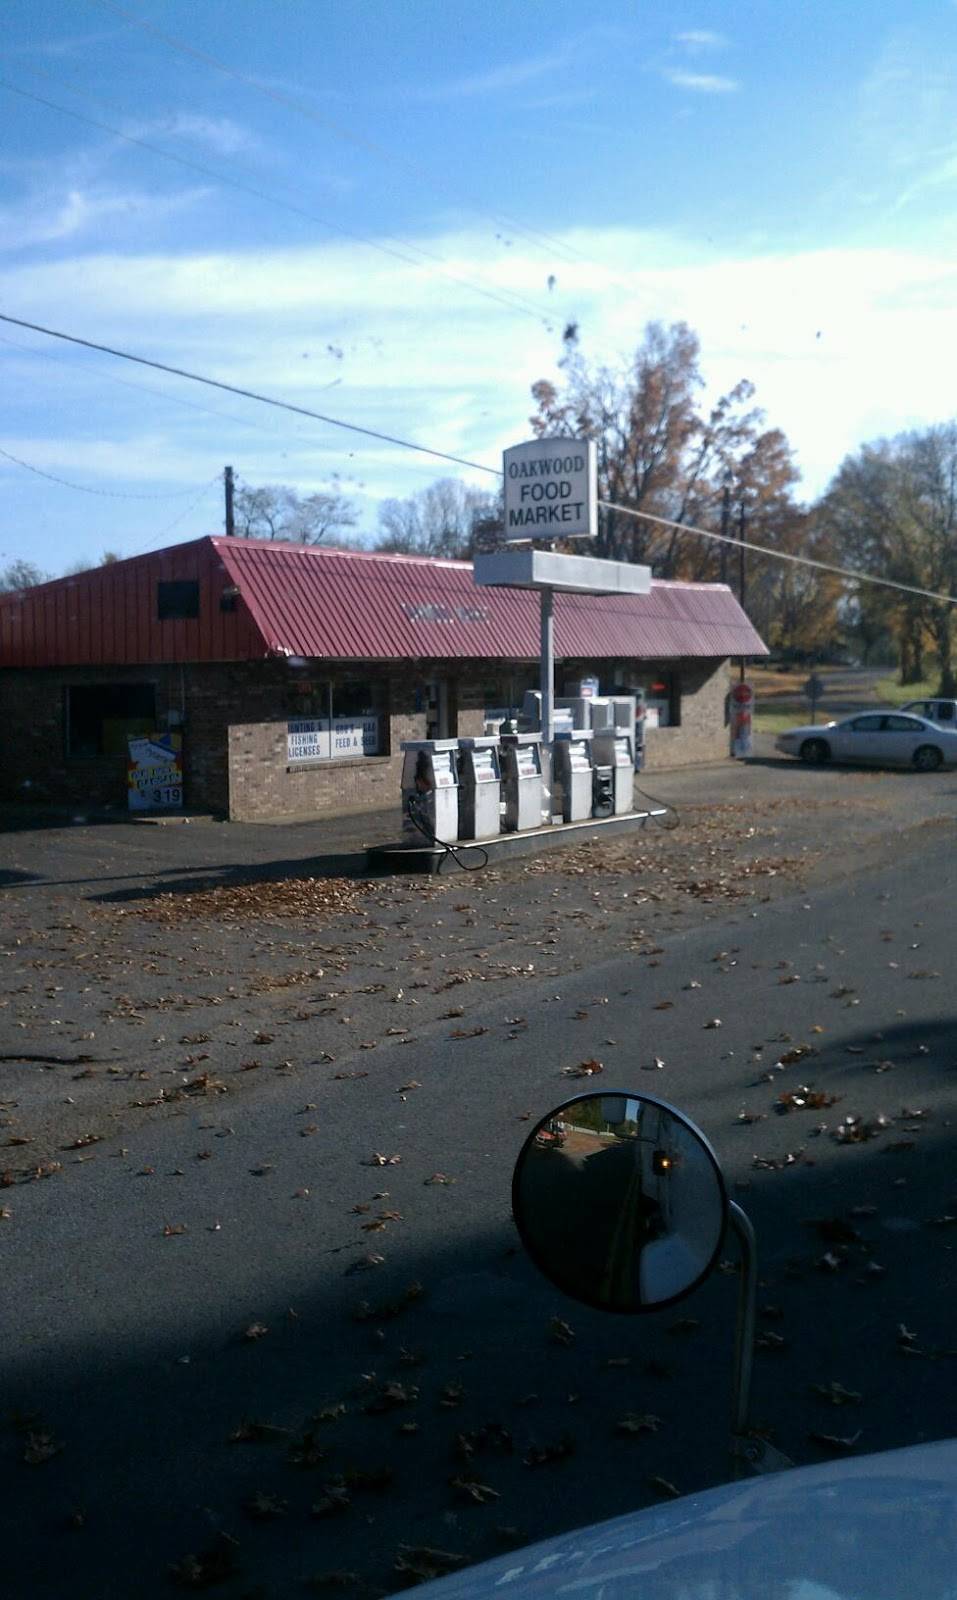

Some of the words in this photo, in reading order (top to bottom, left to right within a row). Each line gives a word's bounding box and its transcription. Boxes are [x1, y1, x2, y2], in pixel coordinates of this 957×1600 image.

[509, 456, 585, 479] OAKWOOD
[521, 481, 571, 502] FOOD
[509, 502, 584, 526] MARKET
[291, 734, 318, 745] FISHING
[336, 737, 351, 748] FEED
[288, 745, 321, 757] LICENSES
